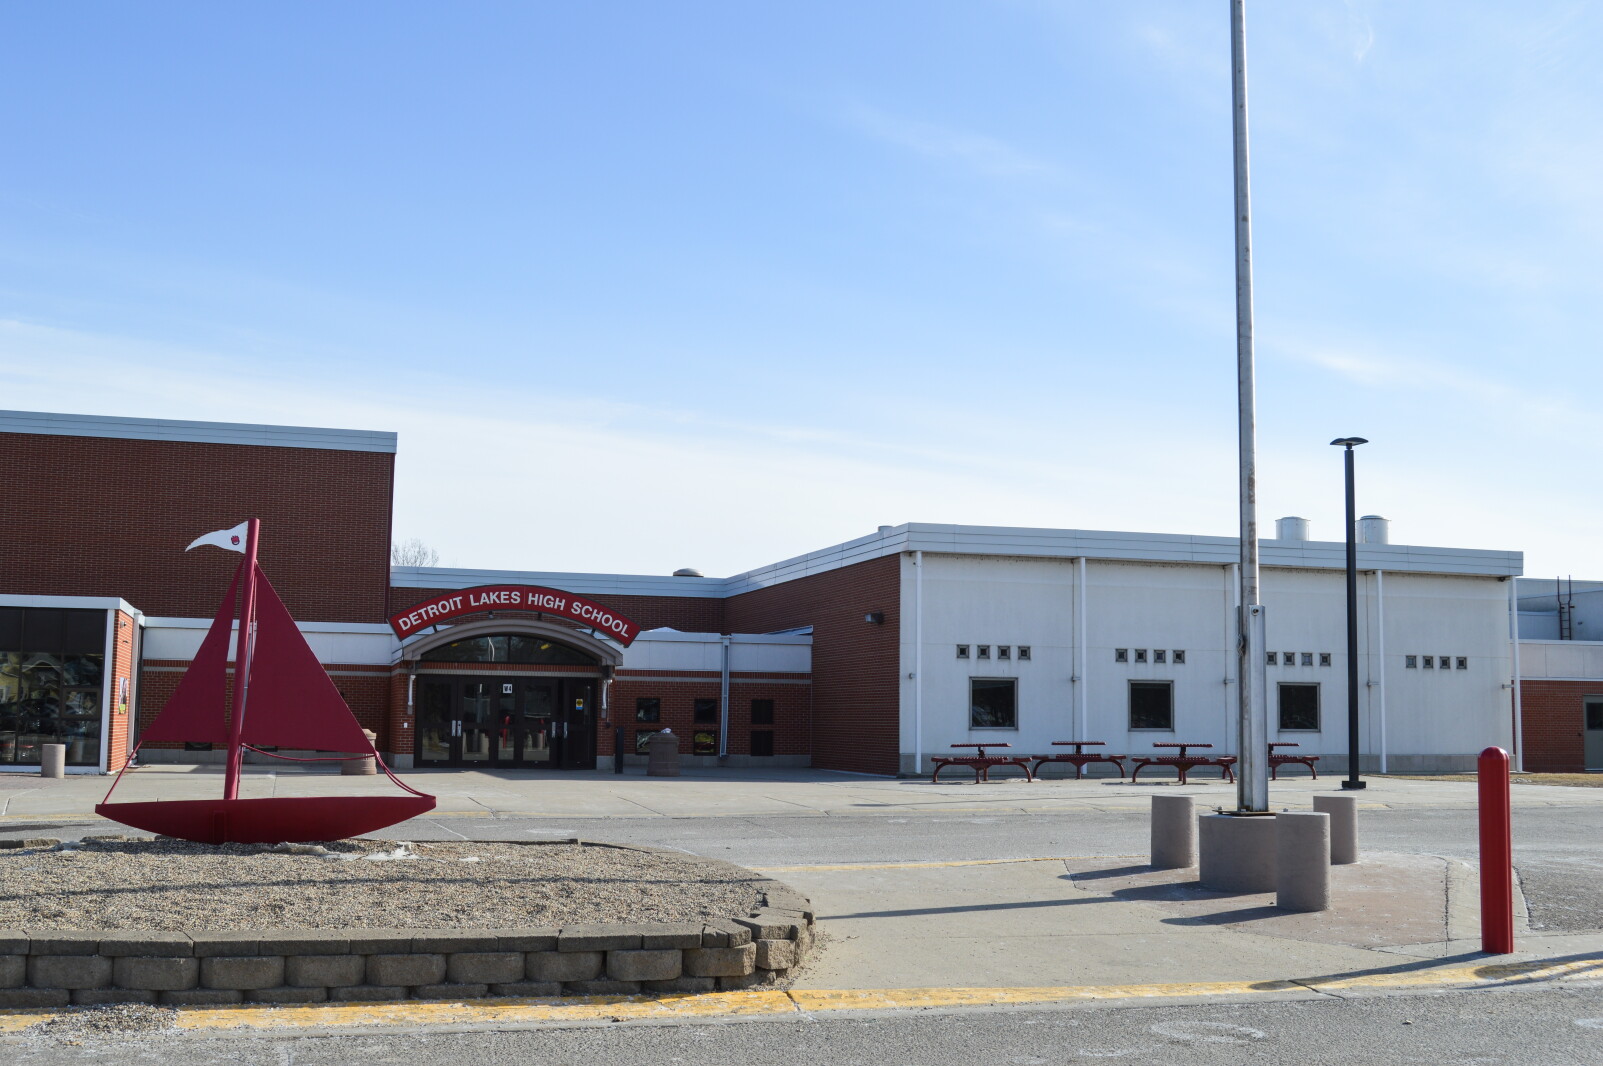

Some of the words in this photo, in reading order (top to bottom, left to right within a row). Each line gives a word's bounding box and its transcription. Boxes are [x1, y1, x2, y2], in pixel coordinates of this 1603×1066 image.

[398, 596, 463, 631] DETROIT
[469, 591, 521, 606] LAKES
[527, 593, 566, 611] HIGH
[571, 601, 629, 637] SCHOOL
